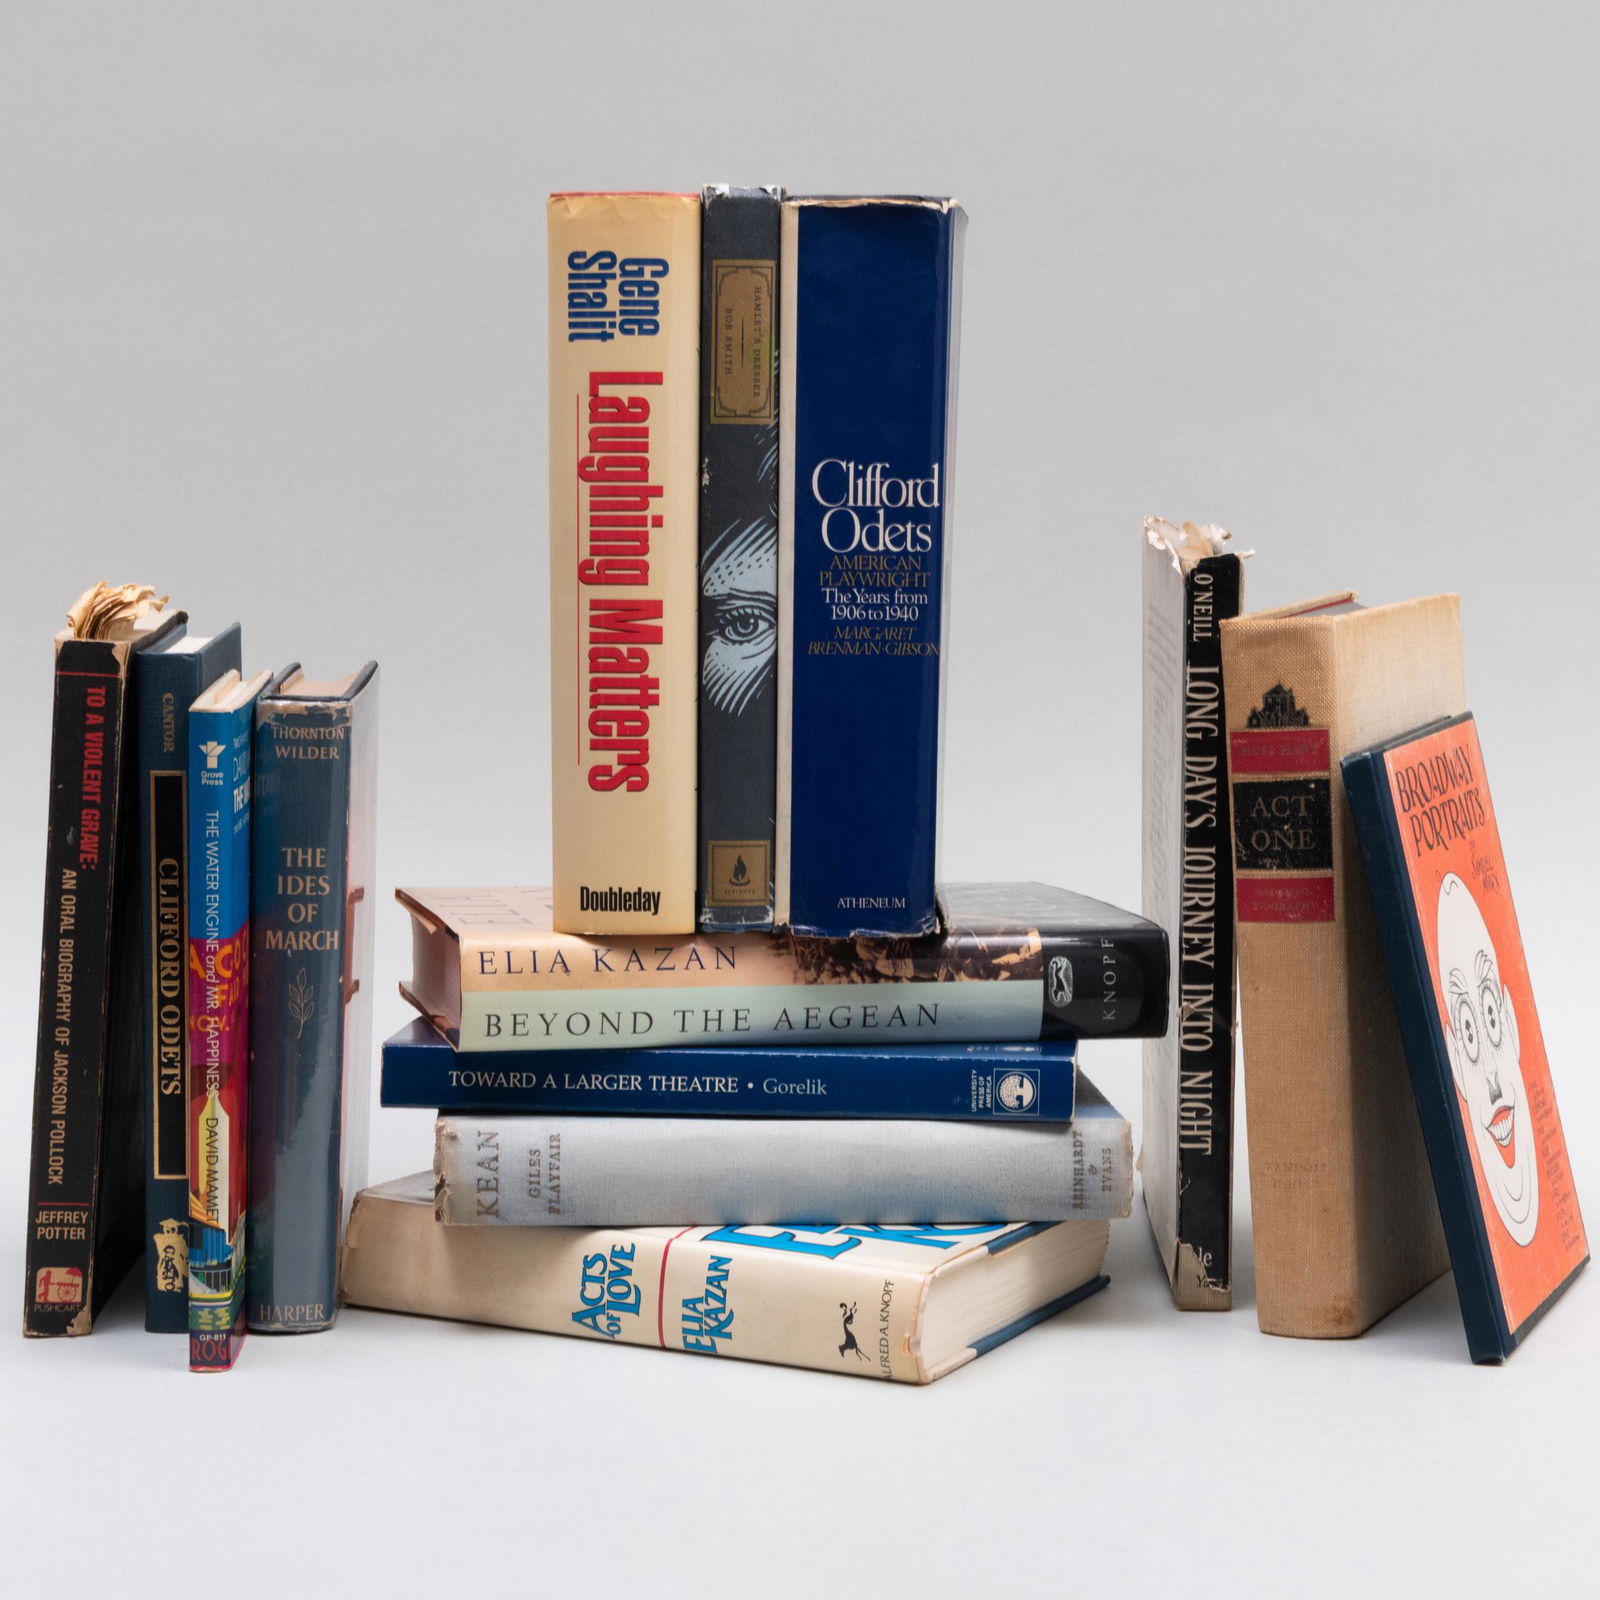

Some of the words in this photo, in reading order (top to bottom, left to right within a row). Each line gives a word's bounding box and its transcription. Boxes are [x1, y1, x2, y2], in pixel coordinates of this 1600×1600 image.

[567, 250, 617, 342] Shalit
[618, 257, 669, 336] Gene
[753, 286, 763, 345] HAMLET'S
[725, 307, 733, 330] BOB
[724, 339, 733, 376] SMITH
[752, 348, 761, 398] DRESSER
[578, 371, 663, 586] Laughing
[811, 458, 940, 508] Clifford
[821, 507, 932, 553] Odets
[819, 572, 931, 587] PLAYWRIGHT
[829, 555, 921, 571] AMERICAN
[821, 587, 852, 604] The
[852, 588, 890, 604] Years
[894, 589, 928, 605] from
[831, 605, 866, 620] 1906
[868, 607, 883, 620] to
[884, 605, 919, 621] 1940
[1193, 573, 1214, 642] O'NEILL
[834, 626, 917, 641] MARGARET
[86, 686, 107, 708] TO
[588, 600, 663, 793] Matters
[1185, 661, 1220, 740] LONG
[85, 712, 104, 725] A
[271, 726, 345, 740] THORNTON
[82, 731, 105, 804] VIOLENT
[274, 746, 340, 760] WILDER
[201, 771, 224, 779] Grove
[201, 778, 224, 786] Press
[1184, 756, 1217, 828] DAY'S
[1395, 744, 1474, 813] BROADWAY
[206, 810, 219, 838] THE
[1250, 795, 1315, 817] ACT
[1410, 787, 1485, 857] PORTRAITS
[79, 808, 100, 870] GRAVE:
[281, 848, 327, 868] THE
[1250, 829, 1316, 851] ONE
[62, 868, 77, 889] AN
[205, 841, 219, 890] WATER
[278, 875, 330, 896] IDES
[60, 895, 76, 934] ORAL
[287, 903, 320, 923] OF
[580, 886, 661, 916] Doubleday
[837, 897, 906, 909] ATHENEUM
[1182, 846, 1217, 969] JOURNEY
[159, 858, 180, 998] CLIFFORD
[206, 897, 219, 953] ENGINE
[265, 930, 339, 951] MARCH
[56, 938, 74, 1022] BIOGRAPHY
[206, 954, 220, 983] and
[477, 949, 571, 976] ELIA
[592, 946, 738, 973] KAZAN
[1102, 938, 1116, 1021] KNOPF
[206, 986, 219, 1013] MR.
[484, 1010, 654, 1038] BEYOND
[673, 1009, 751, 1033] THE
[771, 1003, 940, 1031] AEGEAN
[1181, 983, 1214, 1052] INTO
[55, 1027, 70, 1046] OF
[160, 1004, 181, 1095] ODETS
[206, 1016, 219, 1098] HAPPINESS
[51, 1050, 69, 1115] JACKSON
[448, 1070, 536, 1089] TOWARD
[543, 1075, 558, 1089] A
[564, 1074, 642, 1092] LARGER
[648, 1075, 739, 1094] THEATRE
[762, 1078, 828, 1096] Gorelik
[970, 1069, 978, 1112] UNIVERSITY
[978, 1076, 985, 1086] OF
[1179, 1070, 1213, 1156] NIGHT
[48, 1120, 65, 1185] POLLOCK
[205, 1118, 219, 1166] DAVID
[477, 1130, 499, 1218] KEAN
[529, 1149, 541, 1199] GILES
[548, 1133, 560, 1215] PLAYFAIR
[1072, 1130, 1084, 1209] REINHARDT
[206, 1168, 219, 1224] MAMET
[35, 1211, 89, 1225] JEFFREY
[37, 1227, 86, 1240] POTTER
[571, 1253, 615, 1340] ACTS
[606, 1242, 642, 1317] LOVE
[704, 1255, 734, 1341] KAZAN
[880, 1279, 894, 1322] KNOPF
[34, 1303, 81, 1312] PUSHCART
[260, 1304, 324, 1321] HARPER
[606, 1312, 622, 1335] OF
[681, 1296, 718, 1353] ELIA
[199, 1333, 227, 1341] GP-811
[880, 1338, 892, 1380] ALFRED
